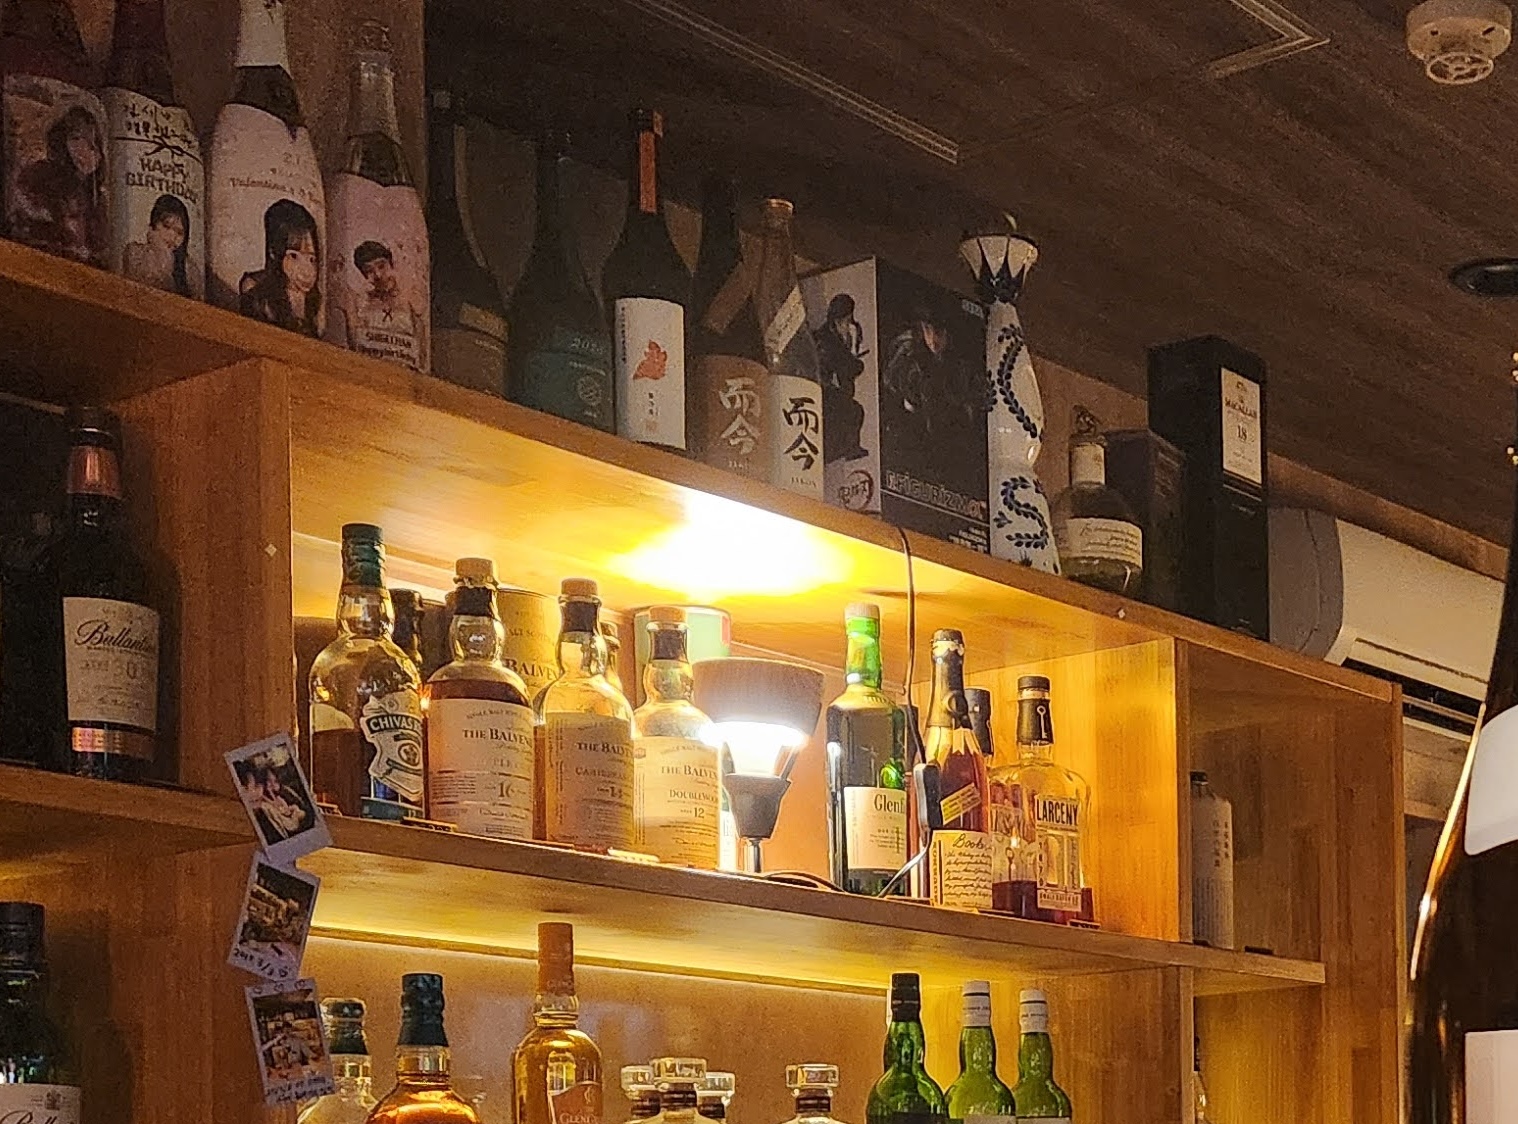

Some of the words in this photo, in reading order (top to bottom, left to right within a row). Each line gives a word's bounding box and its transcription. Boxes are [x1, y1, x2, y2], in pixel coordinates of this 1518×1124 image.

[140, 157, 189, 183] HAPPY
[718, 376, 761, 455] 而今
[782, 397, 819, 471] 而今
[369, 716, 413, 731] CHIVAS
[462, 729, 486, 739] THE
[576, 742, 598, 752] THE
[661, 766, 681, 775] THE
[693, 807, 705, 819] 12
[1036, 799, 1079, 826] LARCENY
